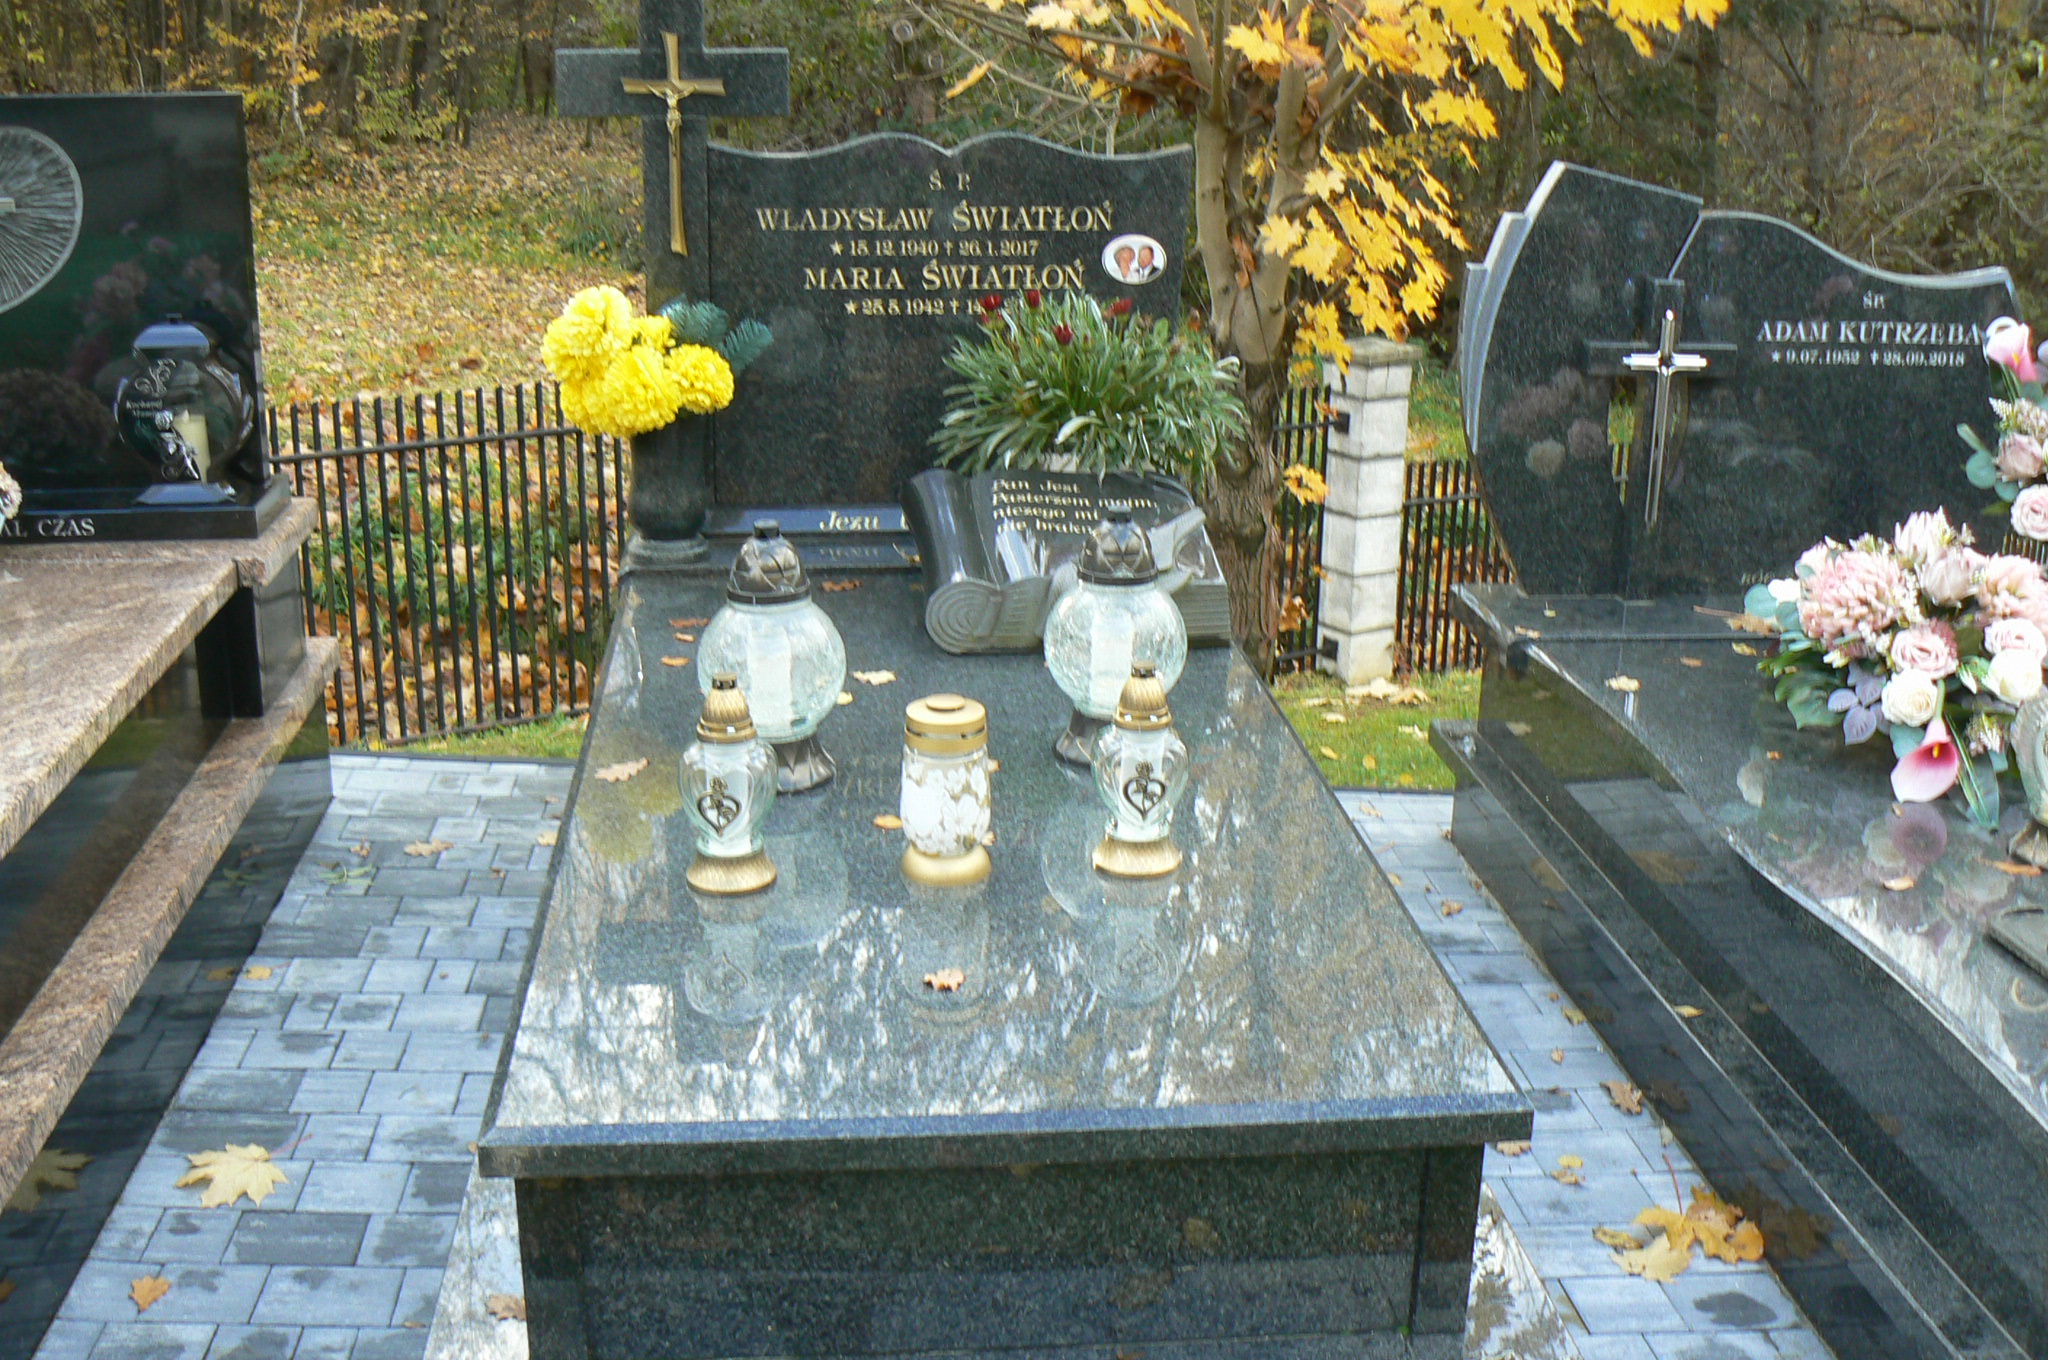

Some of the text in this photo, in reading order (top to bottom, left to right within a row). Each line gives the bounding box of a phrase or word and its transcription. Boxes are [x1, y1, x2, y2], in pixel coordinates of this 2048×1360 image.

[804, 266, 905, 290] MARIA
[1757, 320, 1981, 345] ADAM KUTRZEBA
[37, 518, 96, 537] CZAS
[819, 510, 880, 532] Jezu
